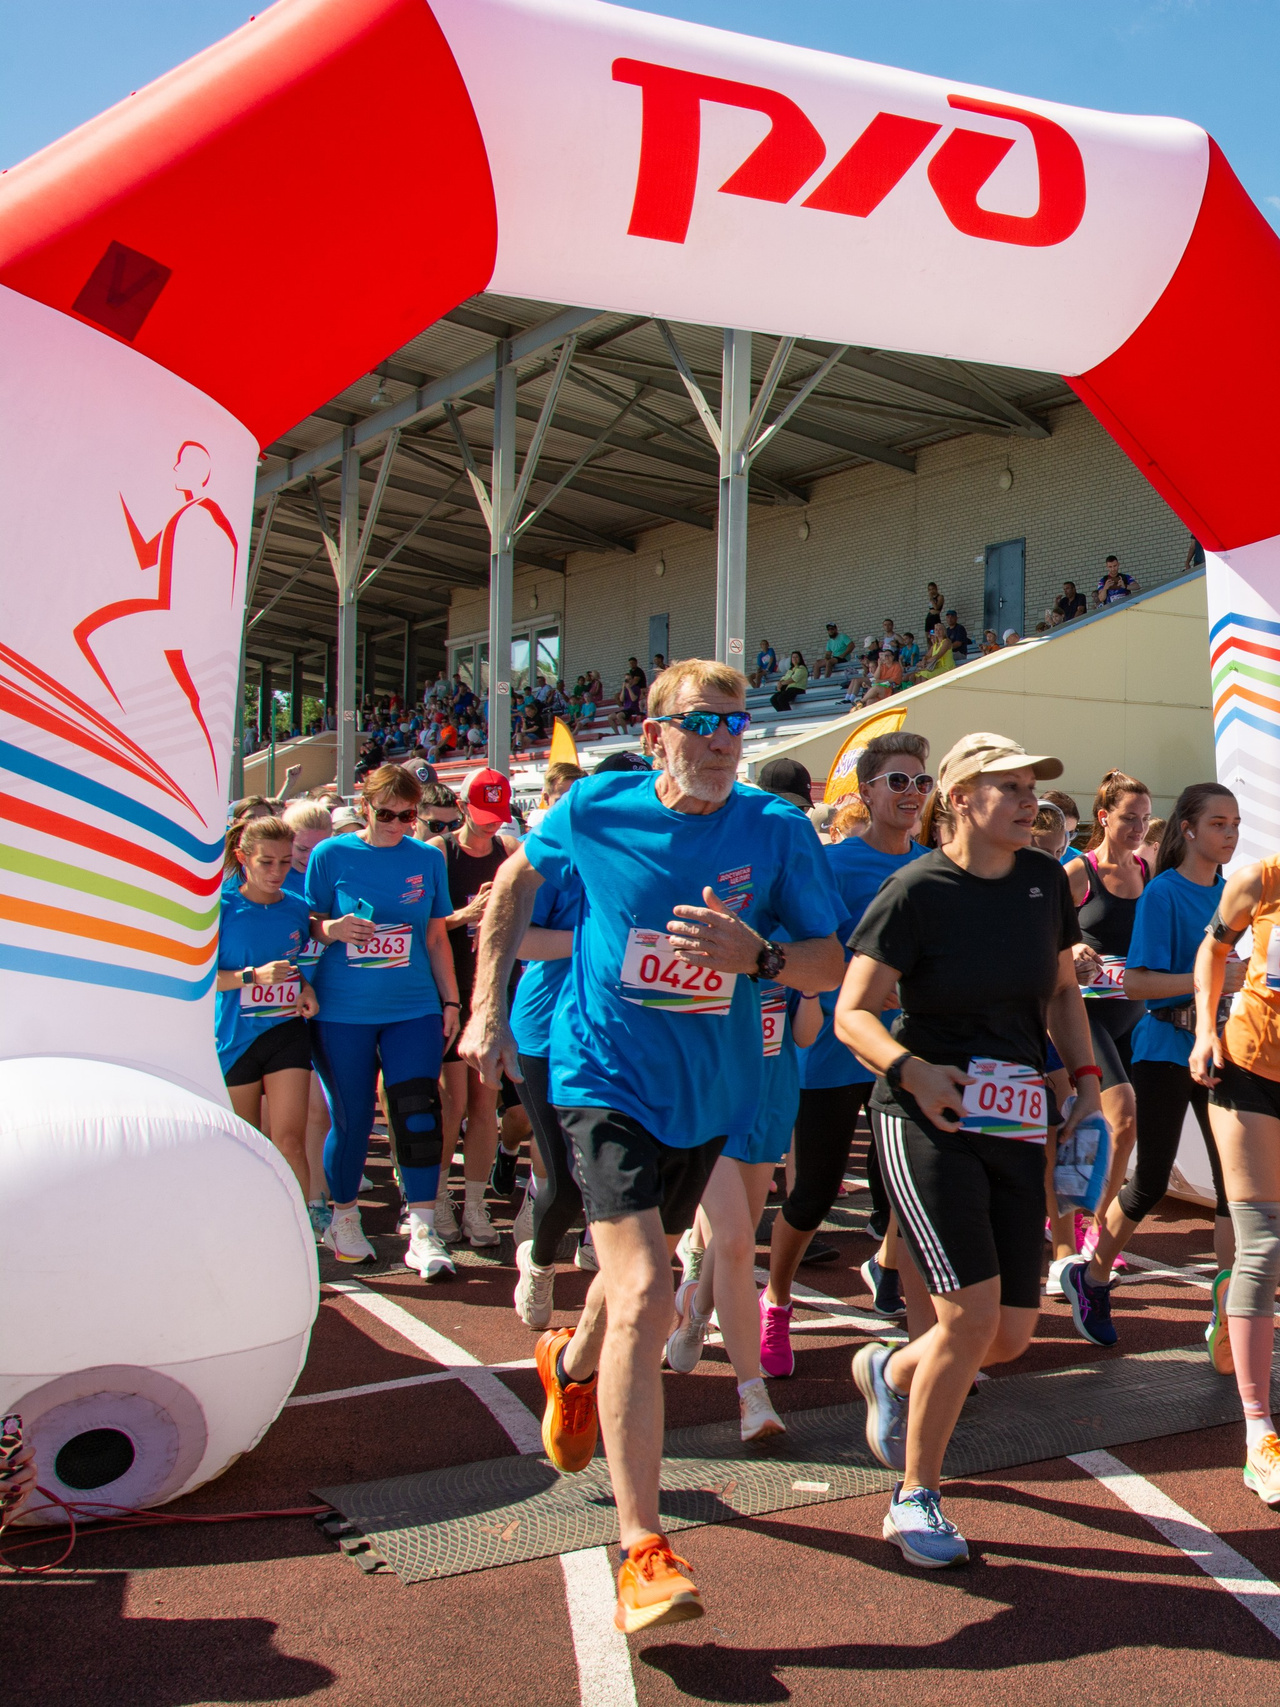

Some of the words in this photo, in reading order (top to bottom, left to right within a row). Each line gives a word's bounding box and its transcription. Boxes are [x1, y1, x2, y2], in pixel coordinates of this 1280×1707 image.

[640, 954, 723, 991] 0426
[252, 984, 296, 1003] 0616
[978, 1082, 1043, 1120] 0318
